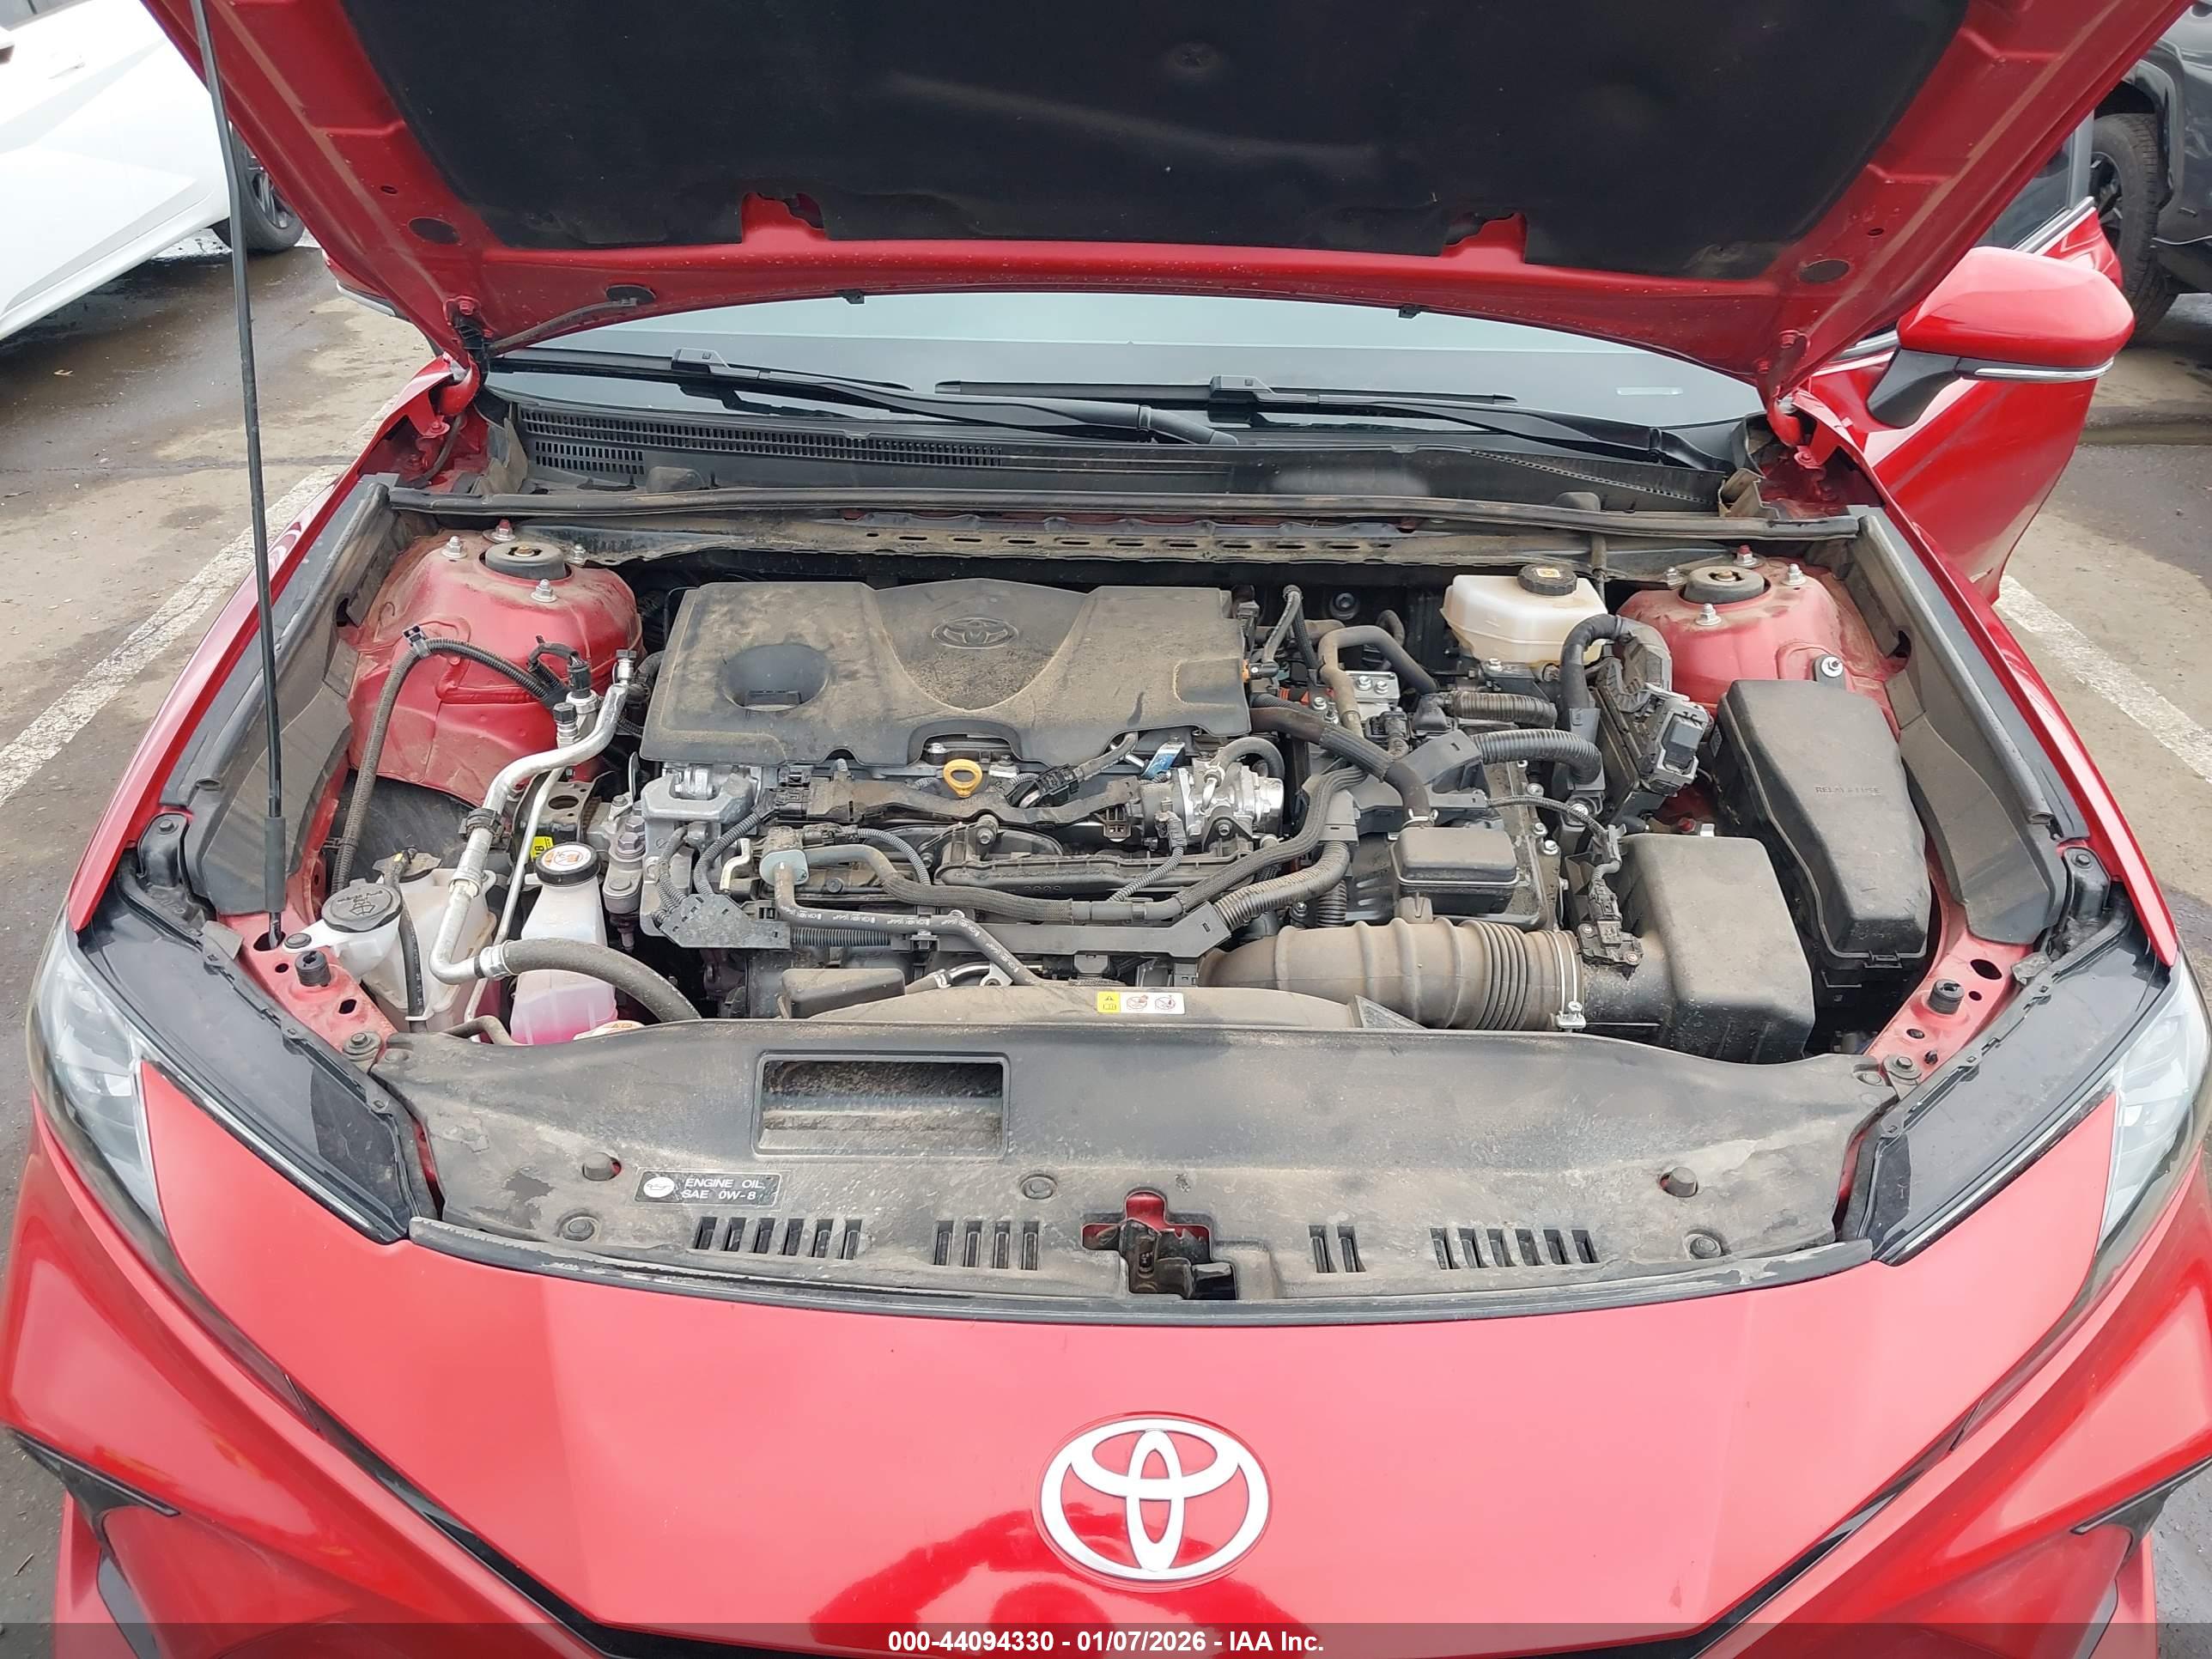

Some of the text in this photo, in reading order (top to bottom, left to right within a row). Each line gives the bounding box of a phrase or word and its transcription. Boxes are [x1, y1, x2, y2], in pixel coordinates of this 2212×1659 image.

[684, 1178, 734, 1188] ENGINE
[682, 1189, 756, 1200] SAE 0W-8
